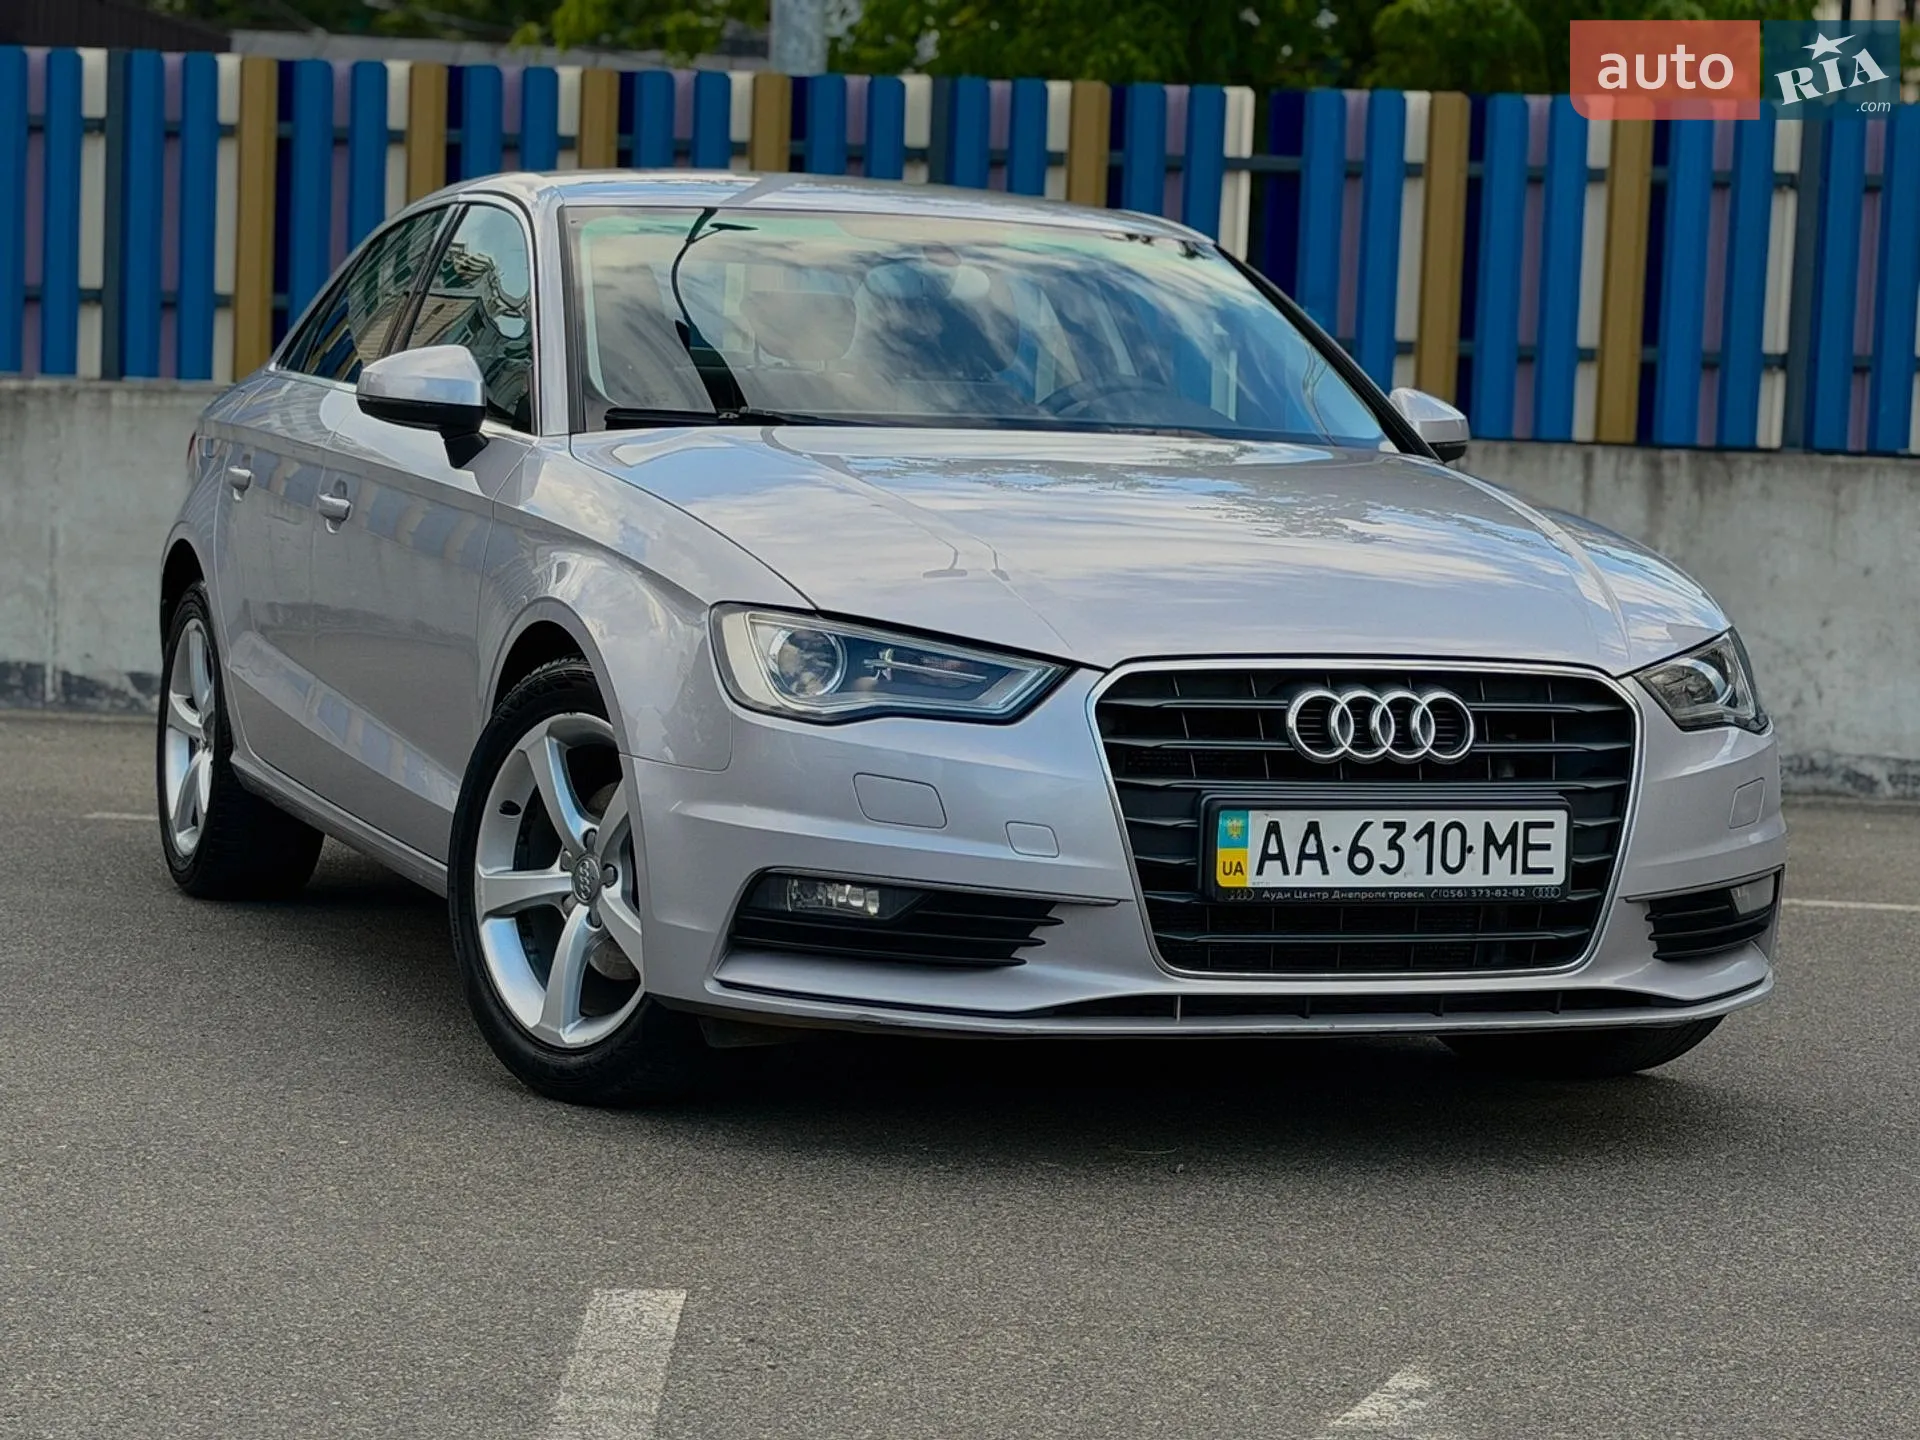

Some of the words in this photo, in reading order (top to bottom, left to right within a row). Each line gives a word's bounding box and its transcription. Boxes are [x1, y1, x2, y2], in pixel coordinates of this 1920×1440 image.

[1222, 860, 1244, 876] UA
[1262, 889, 1291, 900] Ауди
[1294, 889, 1329, 900] Центр
